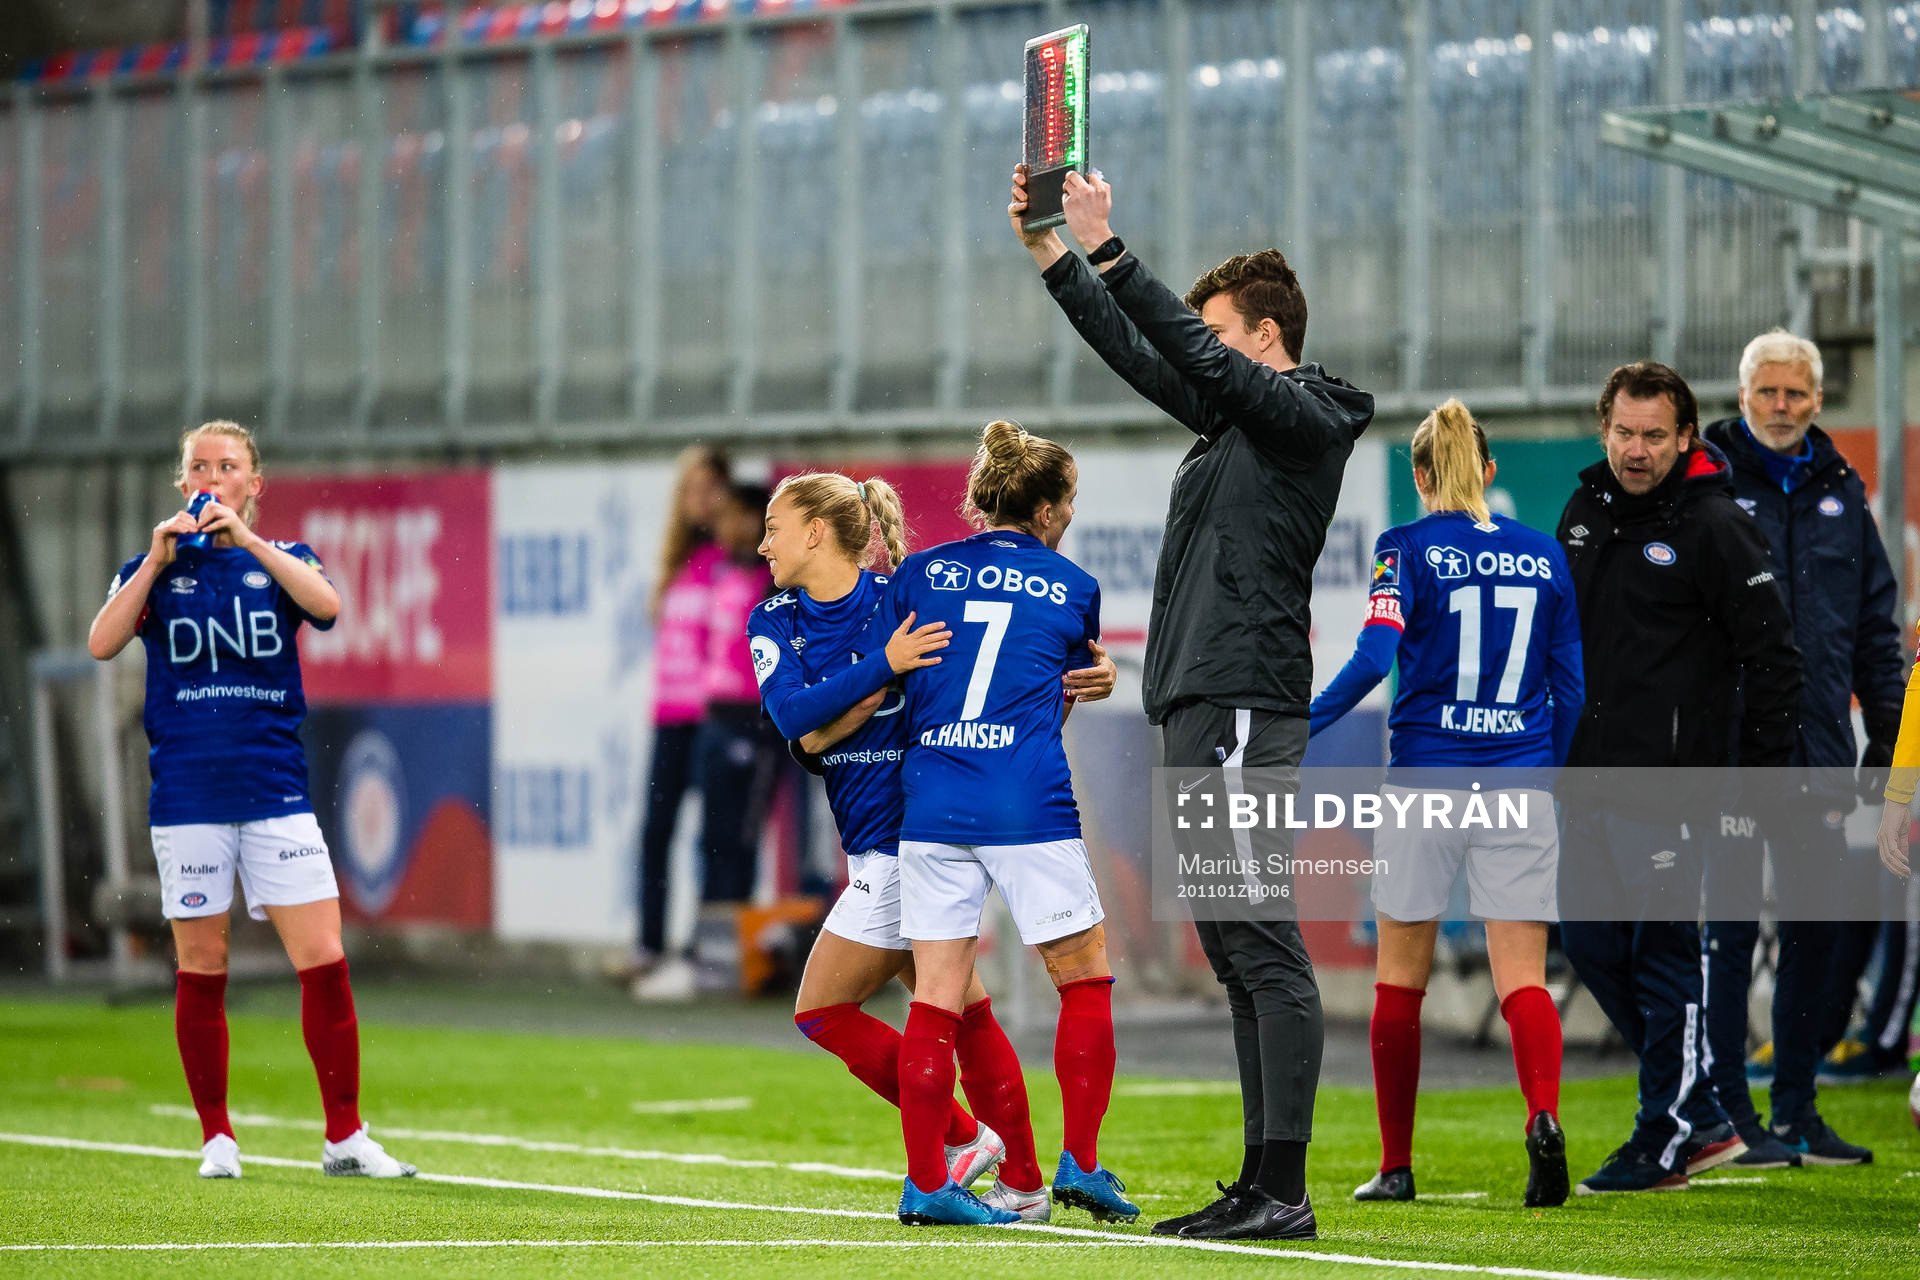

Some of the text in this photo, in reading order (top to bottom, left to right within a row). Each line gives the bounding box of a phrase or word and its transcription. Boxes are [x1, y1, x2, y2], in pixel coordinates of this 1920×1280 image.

[977, 566, 1068, 605] OBOS
[1476, 552, 1552, 579] OBOS
[169, 596, 283, 673] DNB
[960, 600, 1013, 721] 7
[1449, 586, 1538, 704] 17
[175, 684, 287, 702] #huninvesterer
